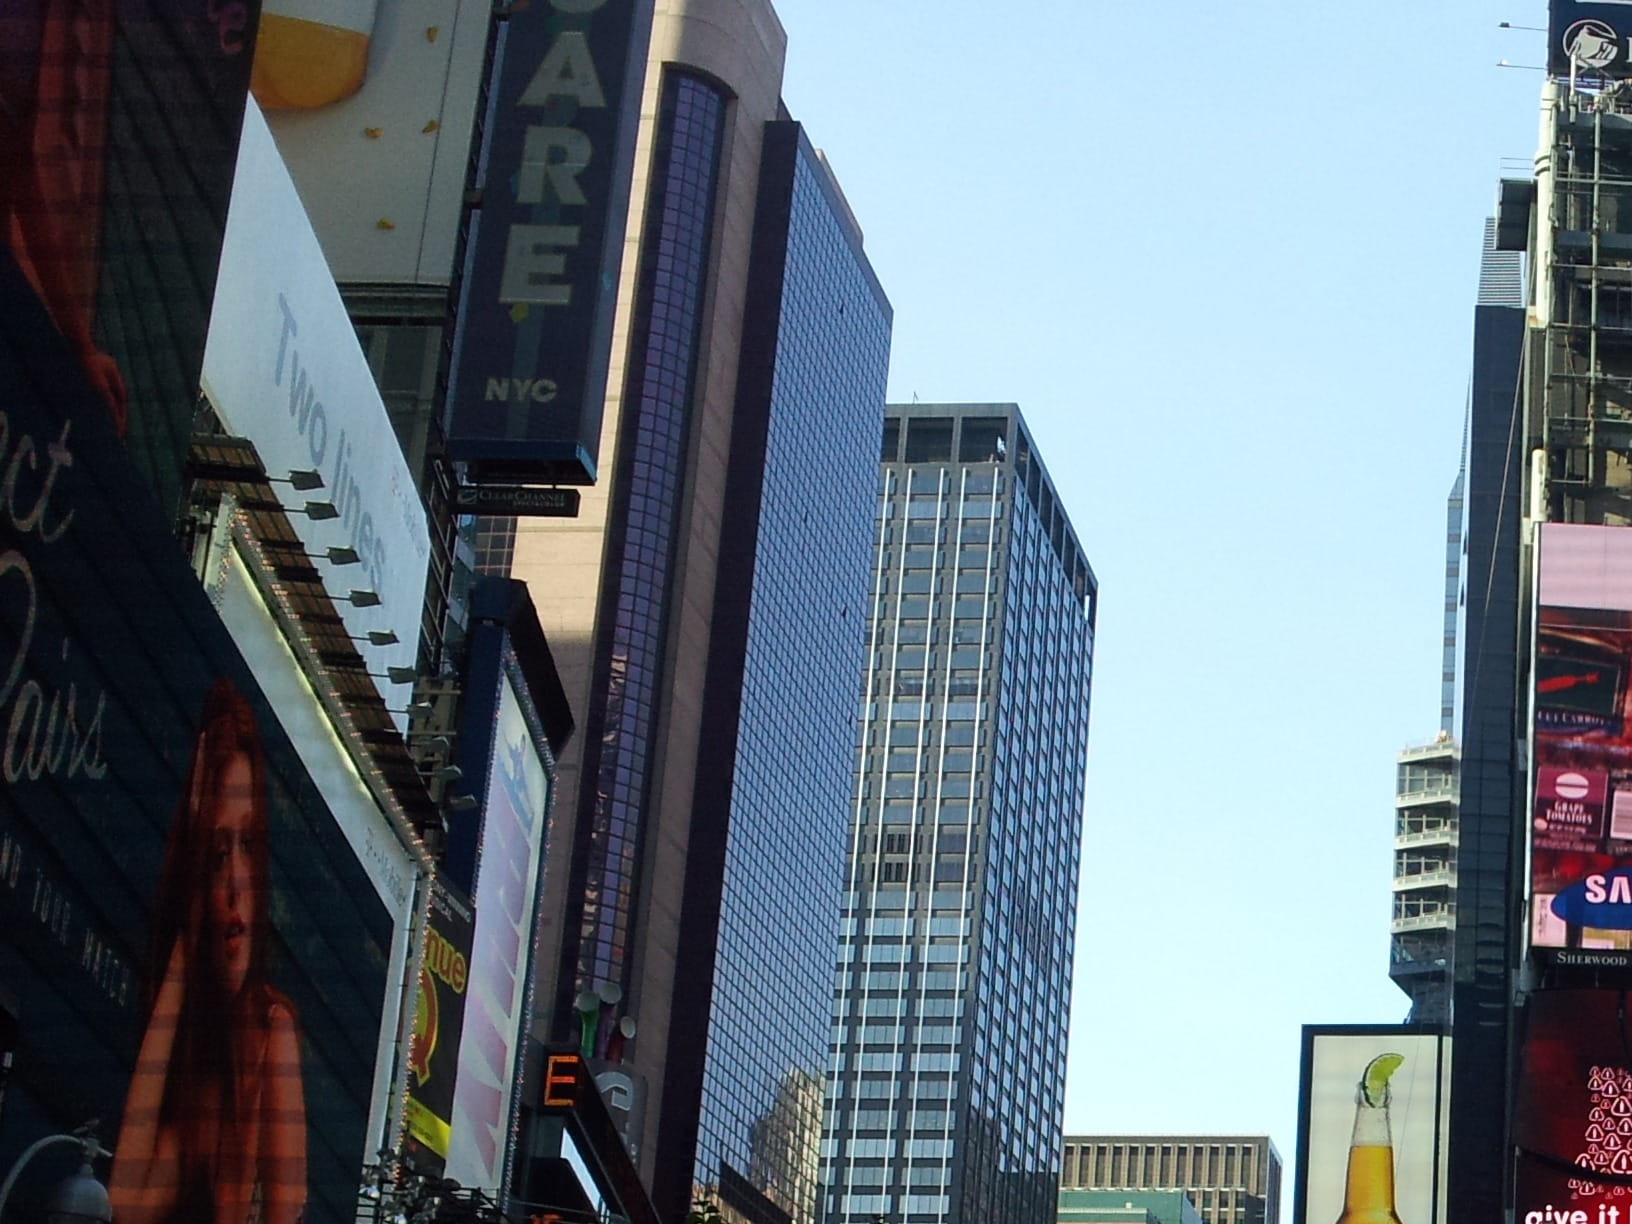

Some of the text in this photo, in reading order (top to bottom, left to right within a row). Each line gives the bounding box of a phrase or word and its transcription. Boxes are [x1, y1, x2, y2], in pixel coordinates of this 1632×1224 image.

[276, 292, 328, 464] Two
[484, 378, 558, 402] NYC
[332, 430, 386, 591] lines
[1554, 801, 1584, 813] GRAPE
[1557, 951, 1628, 966] SHERWOOD
